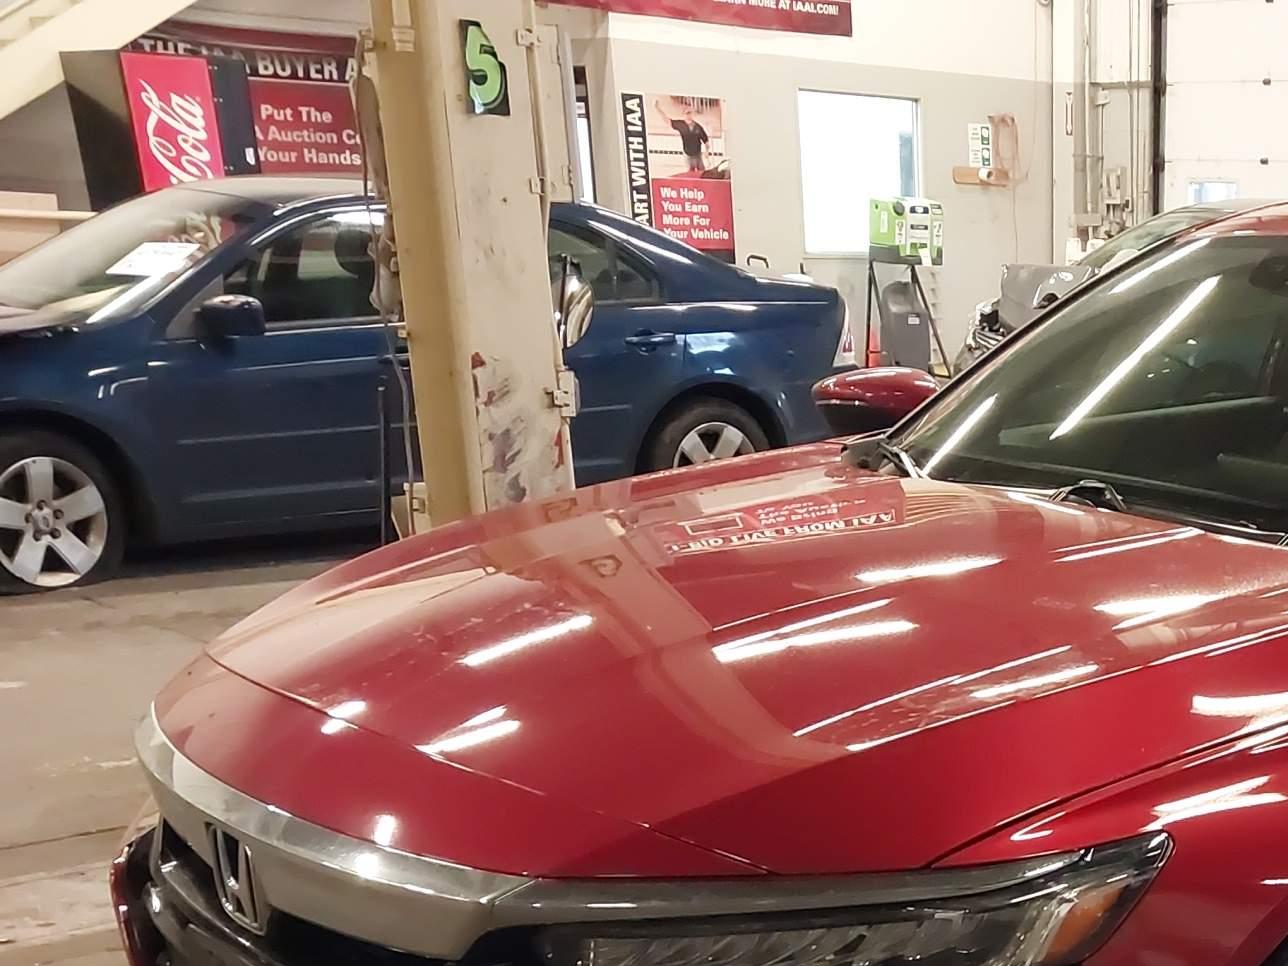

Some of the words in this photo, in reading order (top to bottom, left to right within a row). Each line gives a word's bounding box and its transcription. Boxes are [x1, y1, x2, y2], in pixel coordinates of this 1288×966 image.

[257, 52, 339, 81] BUYER
[465, 24, 502, 105] 5
[260, 104, 293, 123] Put
[299, 106, 333, 124] The
[625, 97, 643, 132] IAA
[267, 126, 338, 145] Auction
[258, 147, 298, 164] Your
[303, 148, 362, 166] Hands
[629, 137, 648, 187] WITH
[660, 187, 677, 199] We
[680, 187, 705, 201] Help
[661, 200, 682, 212] You
[685, 202, 709, 213] Earn
[663, 214, 690, 226] More
[693, 215, 711, 226] For
[663, 228, 689, 239] Your
[691, 228, 730, 241] Vehicle
